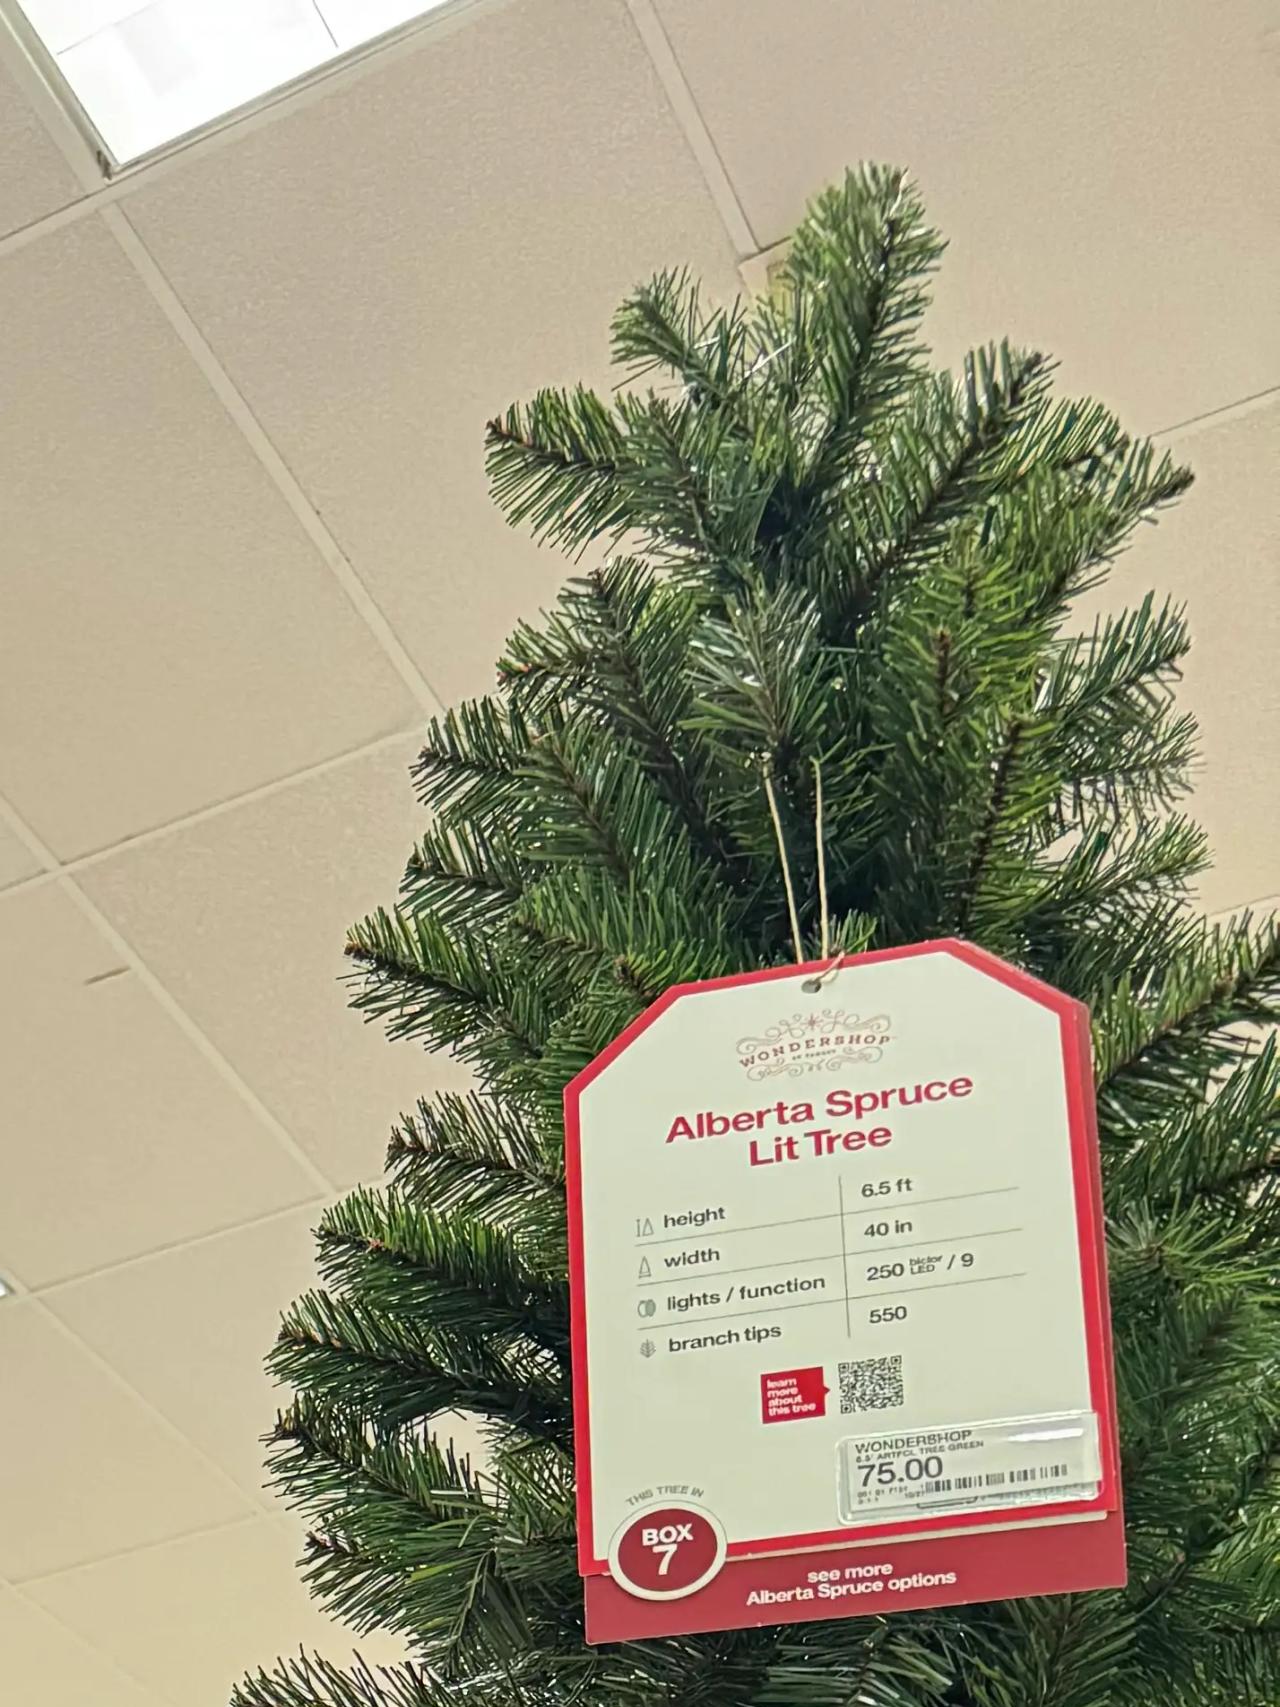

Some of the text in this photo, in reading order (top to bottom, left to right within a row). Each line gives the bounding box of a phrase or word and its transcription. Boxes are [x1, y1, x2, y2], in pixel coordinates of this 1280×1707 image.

[739, 1034, 891, 1068] WONDERSHOP
[665, 1076, 973, 1143] Alberta Spruce
[749, 1126, 892, 1166] Lit Tree
[861, 1178, 912, 1198] 6.5 ft
[664, 1207, 725, 1228] height
[864, 1220, 912, 1237] 40 in
[664, 1248, 720, 1267] width
[867, 1263, 904, 1281] 250
[910, 1264, 935, 1275] LED
[947, 1254, 956, 1270] /
[960, 1252, 974, 1267] 9
[667, 1277, 825, 1312] lights / function
[869, 1306, 907, 1323] 550
[669, 1326, 782, 1352] branch tips
[766, 1378, 797, 1389] learn
[767, 1387, 798, 1398] more
[768, 1394, 802, 1407] about
[768, 1403, 816, 1416] this tree
[855, 1429, 972, 1454] WONDERSHOP
[857, 1455, 943, 1488] 75.00
[625, 1485, 704, 1506] THIS TREE IN
[642, 1522, 694, 1546] BOX
[652, 1543, 678, 1575] 7
[807, 1563, 893, 1583] see more
[746, 1571, 957, 1606] Alberta Spruce options
